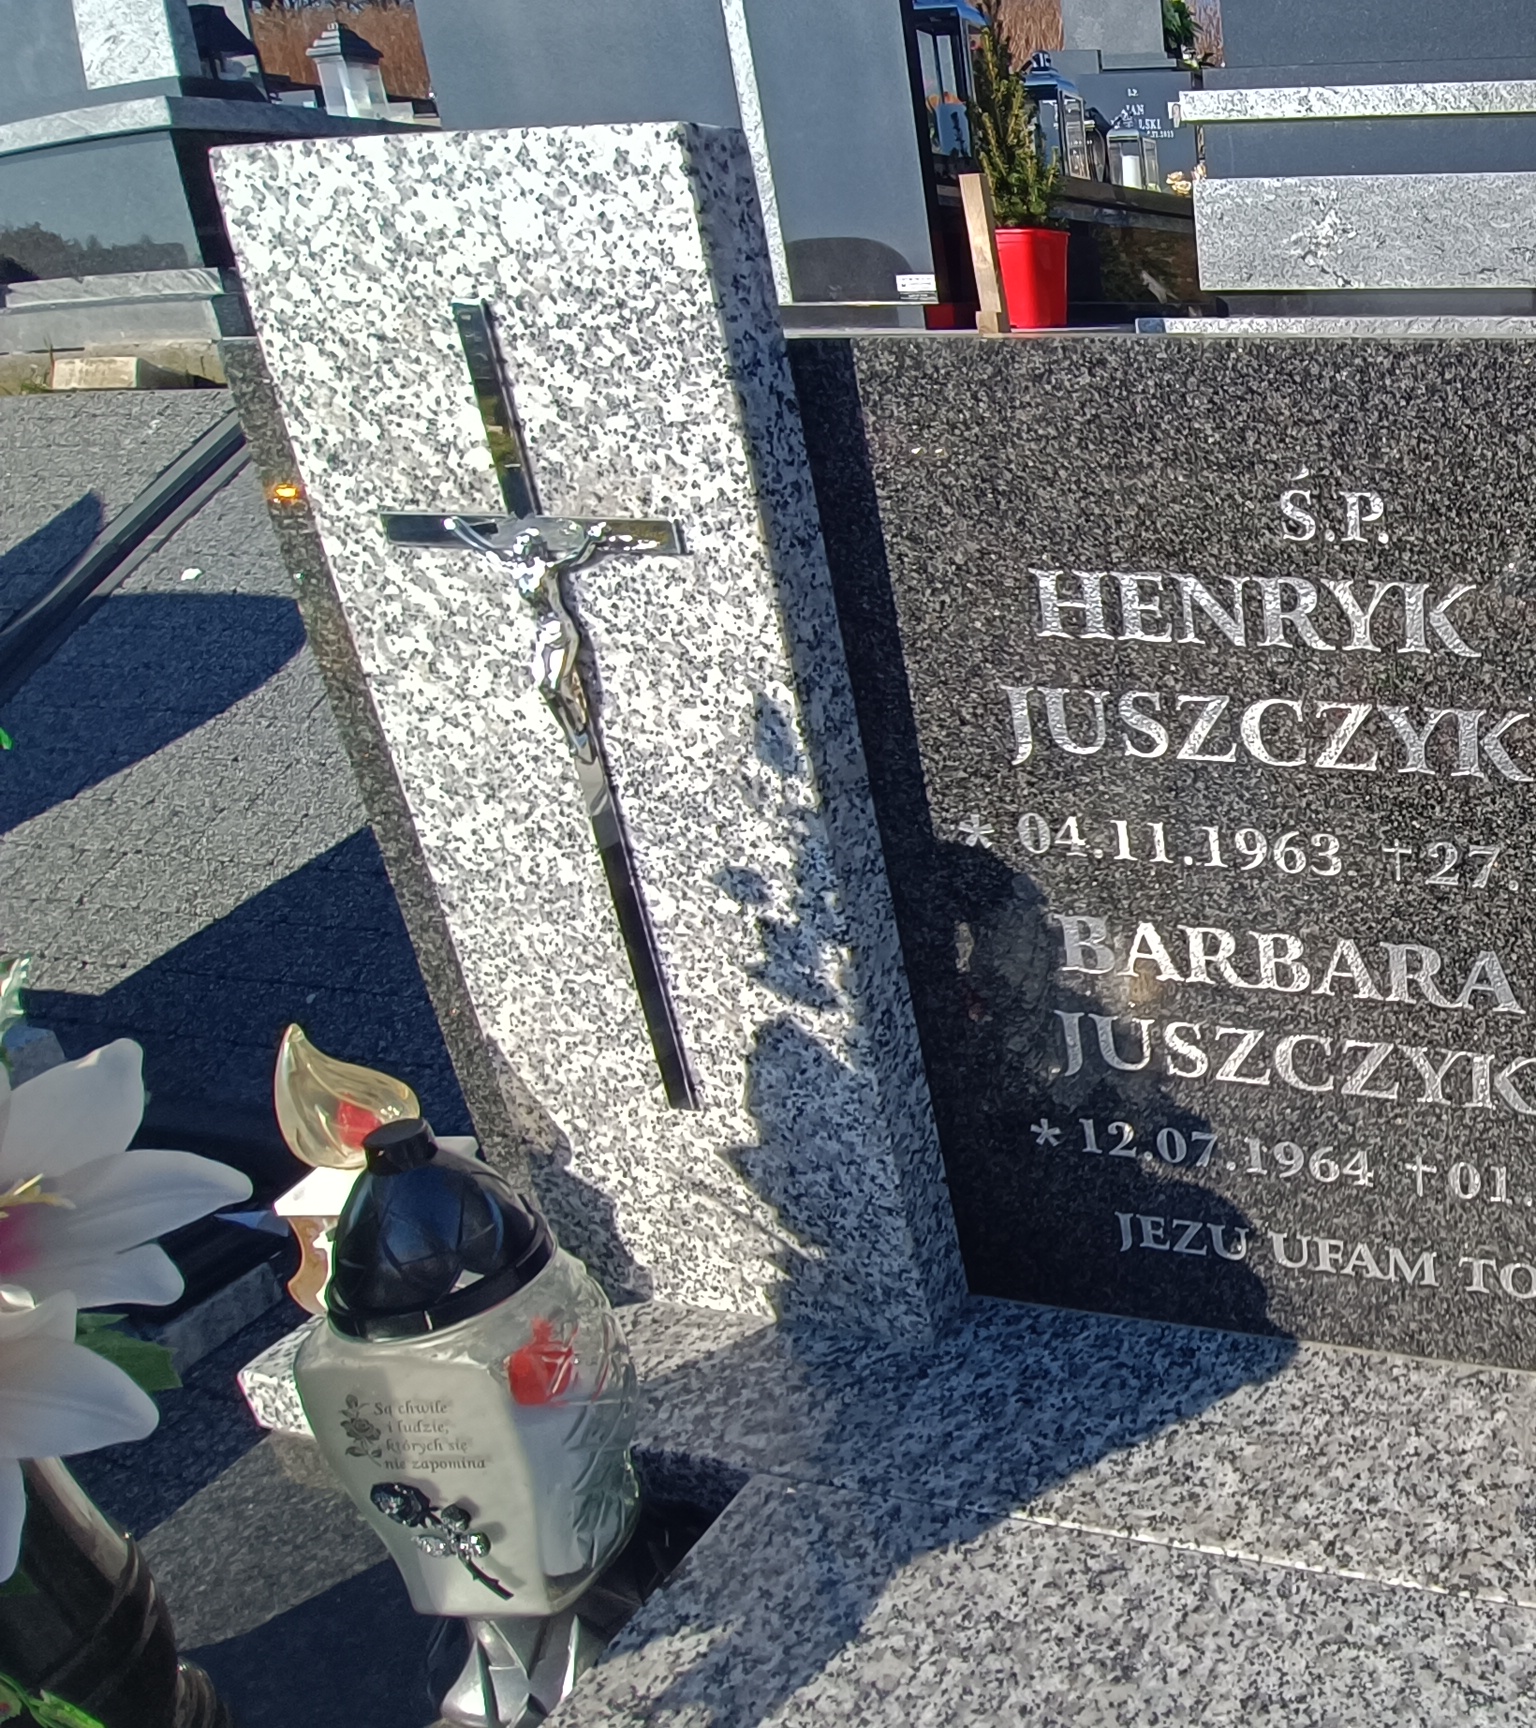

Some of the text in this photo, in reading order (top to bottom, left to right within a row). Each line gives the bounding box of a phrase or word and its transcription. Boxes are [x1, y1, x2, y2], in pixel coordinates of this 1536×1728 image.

[1280, 465, 1389, 544] Ś.P.
[1027, 567, 1482, 658] HENRYK
[999, 684, 1535, 783] JUSZCZYK
[1016, 811, 1342, 876] 04.11.1963
[1052, 912, 1526, 1016] BARBARA
[1078, 1117, 1374, 1188] 12.07.1964
[1114, 1210, 1249, 1262] JEZU
[1266, 1229, 1440, 1289] UFAM
[373, 1400, 449, 1417] Są chwile
[397, 1419, 450, 1435] ludzie,
[384, 1458, 487, 1474] nie zapomina
[385, 1438, 469, 1455] których się
